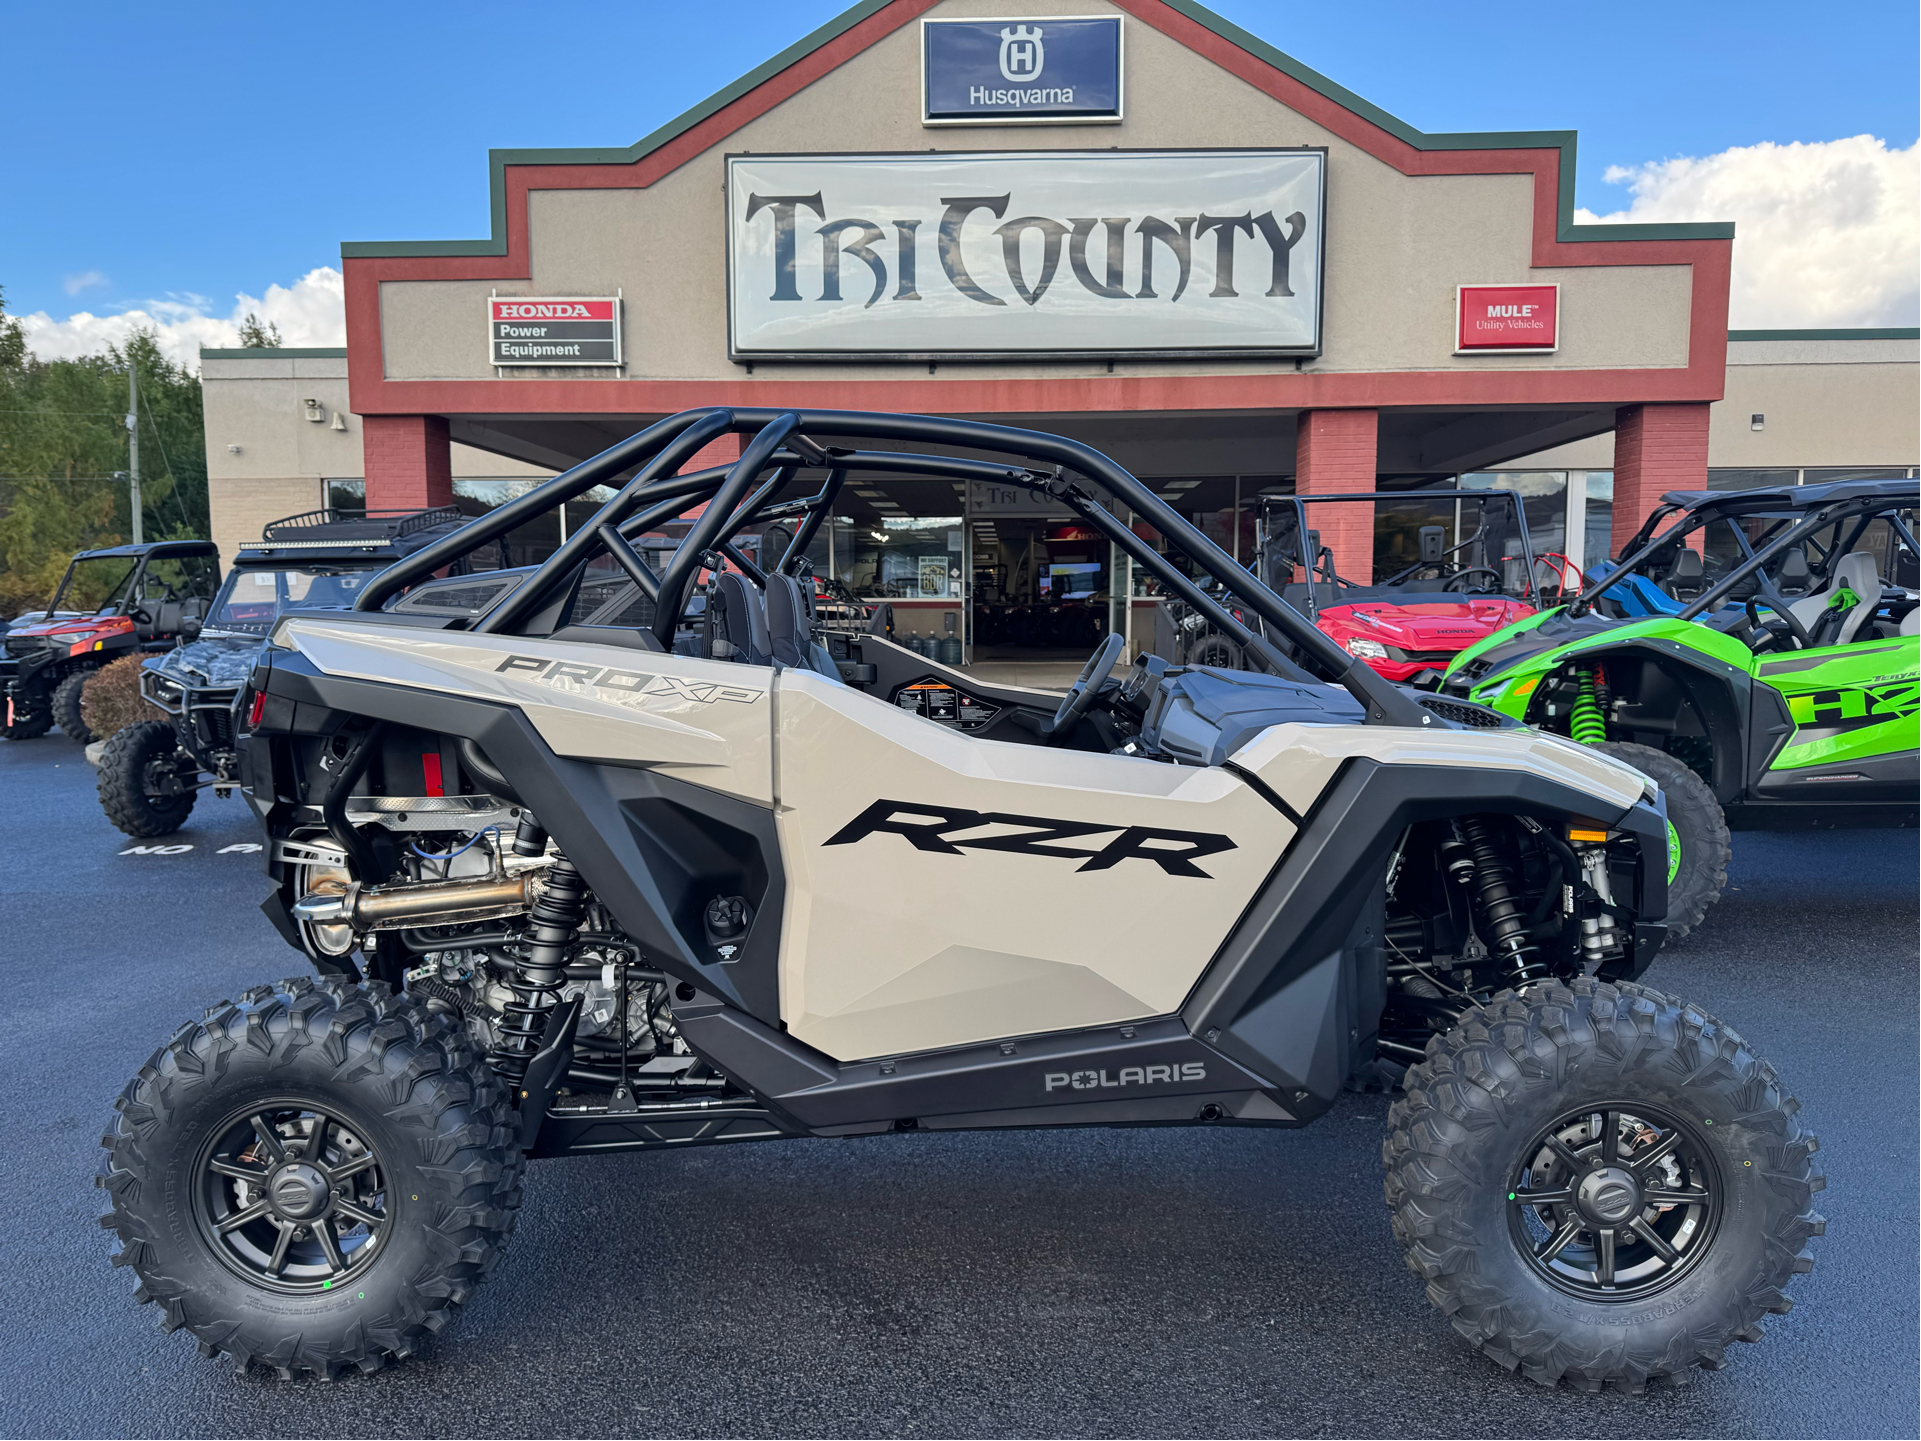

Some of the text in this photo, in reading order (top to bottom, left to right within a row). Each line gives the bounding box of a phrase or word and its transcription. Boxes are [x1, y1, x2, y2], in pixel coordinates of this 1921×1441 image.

[970, 86, 1074, 107] Husqvarna
[745, 190, 1307, 309] TRI COUNTY
[500, 304, 591, 317] HONDA
[500, 324, 547, 337] Power
[1476, 320, 1544, 331] Utility Vehicles
[501, 343, 580, 358] Equipment
[923, 574, 943, 590] BDR
[820, 798, 1239, 879] RZR
[117, 844, 194, 856] NO
[1044, 1062, 1206, 1091] POLARIS
